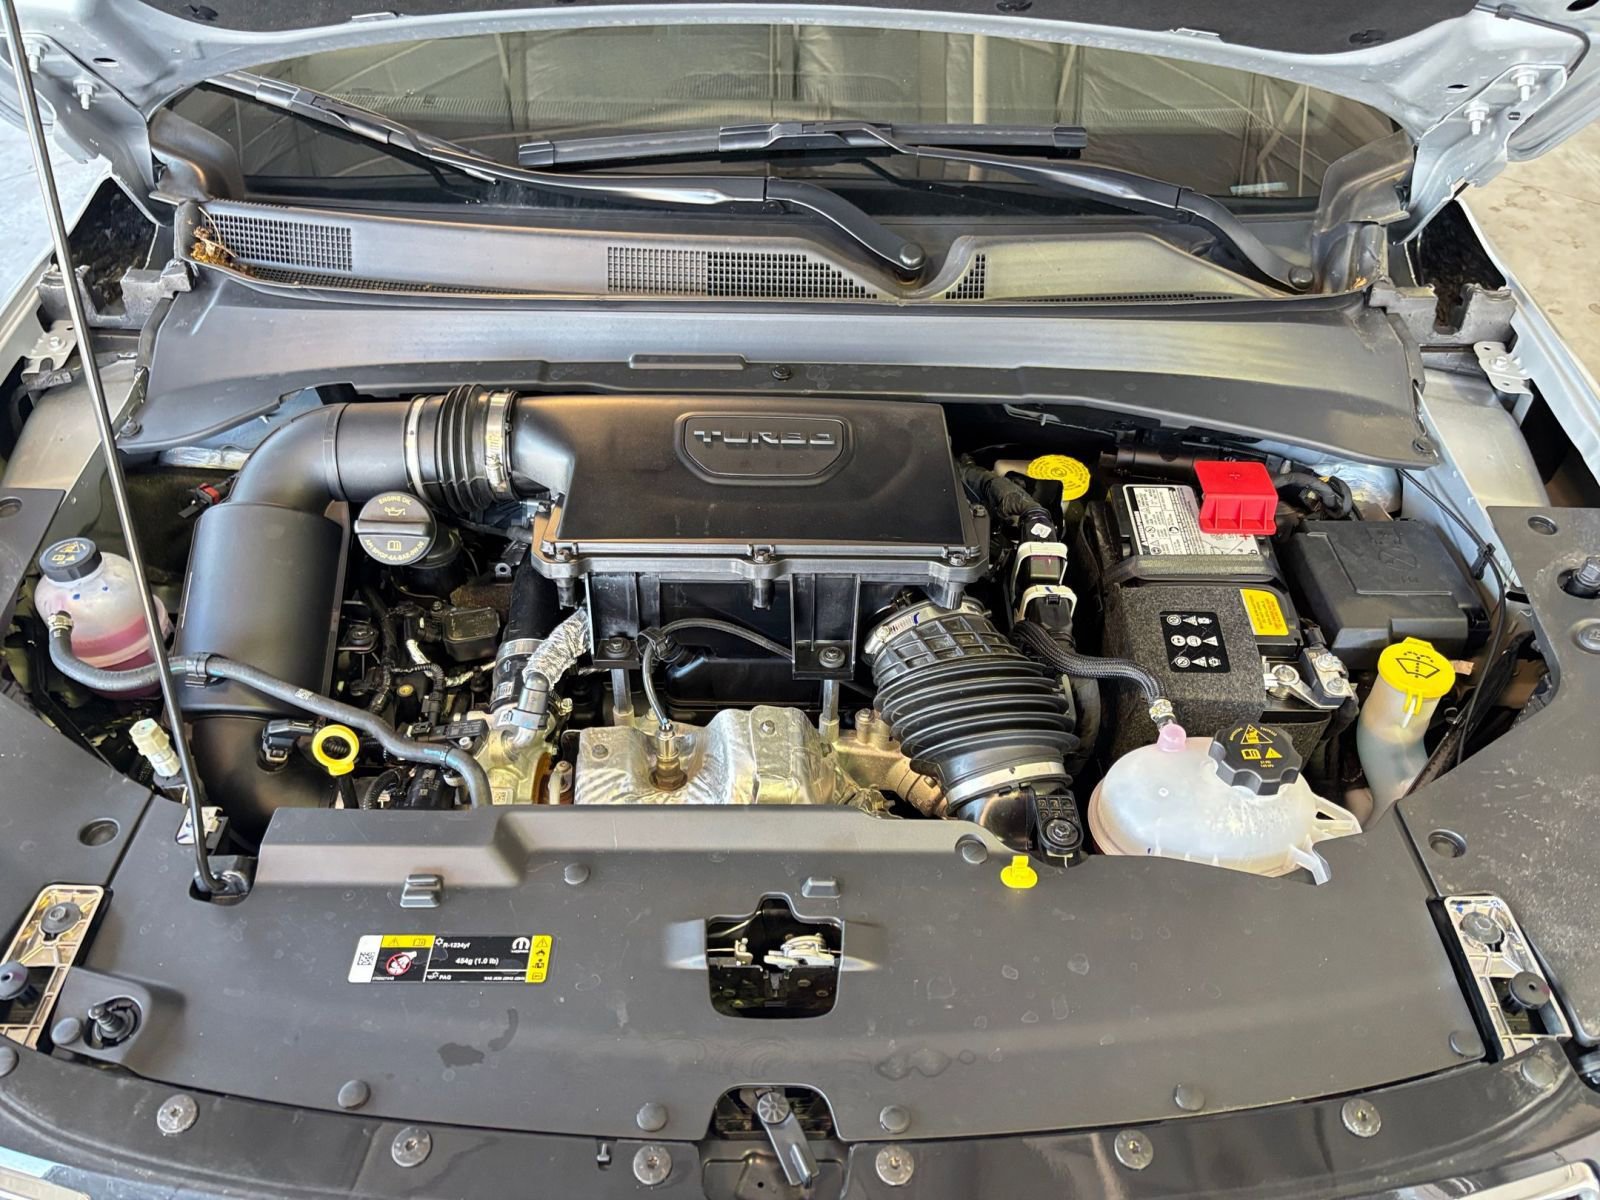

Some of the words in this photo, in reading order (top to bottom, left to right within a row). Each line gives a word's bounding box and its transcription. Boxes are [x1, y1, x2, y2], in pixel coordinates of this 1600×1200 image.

[693, 430, 836, 446] TURBO
[379, 495, 401, 504] ENGINE
[474, 957, 488, 965] (1.0
[489, 957, 499, 965] lb)
